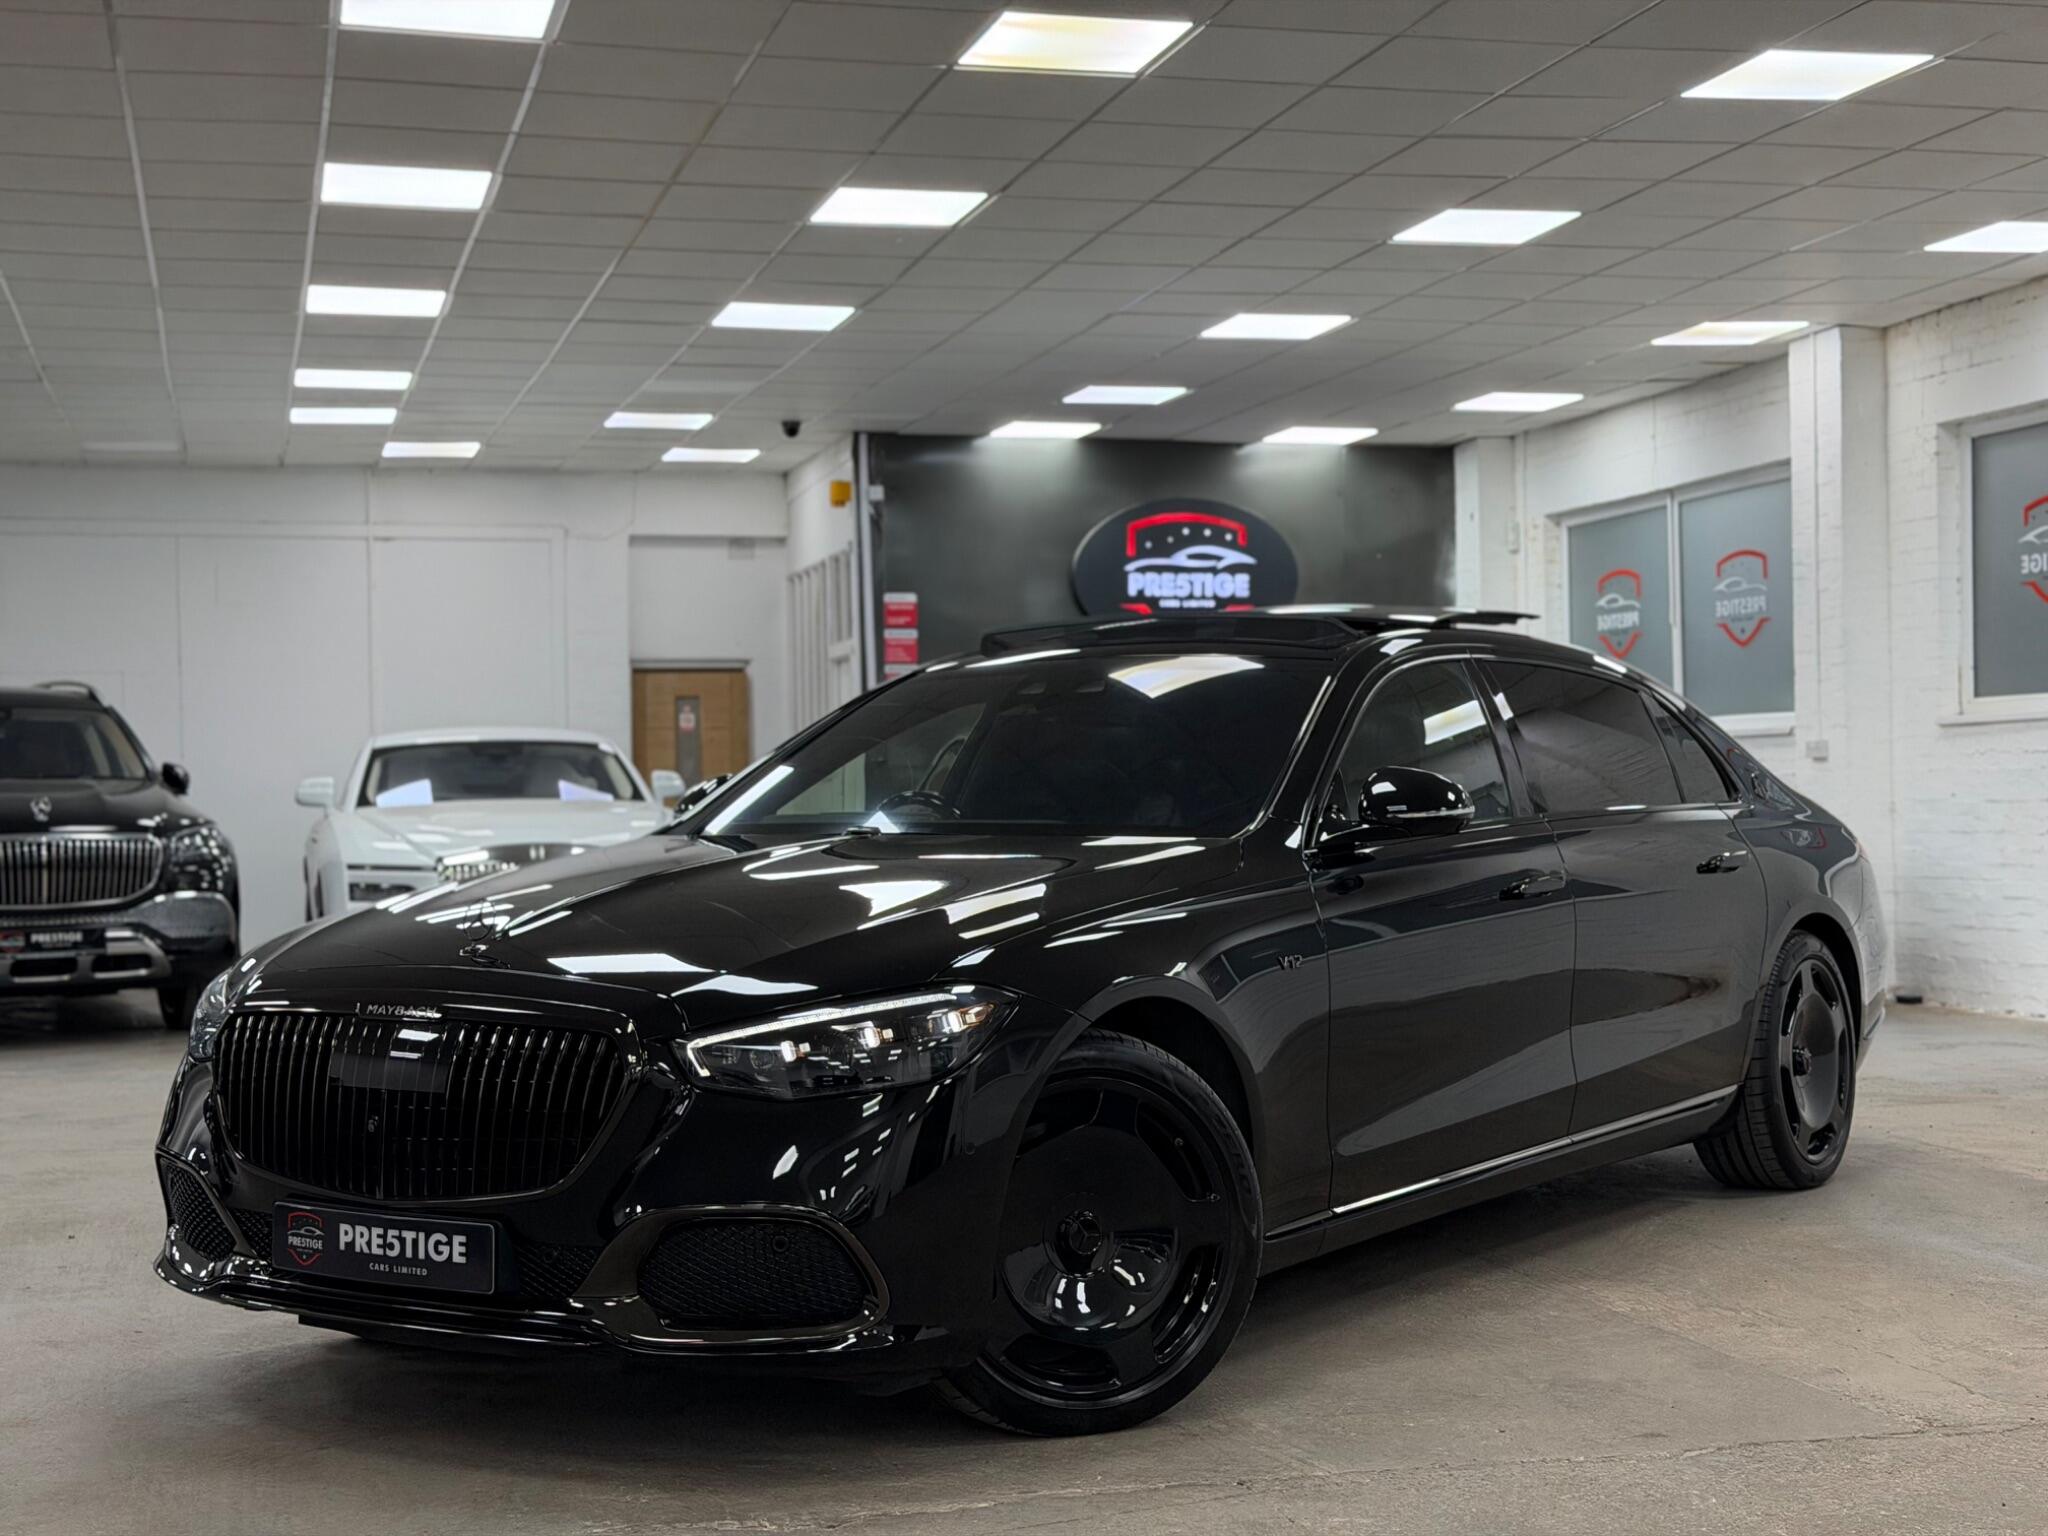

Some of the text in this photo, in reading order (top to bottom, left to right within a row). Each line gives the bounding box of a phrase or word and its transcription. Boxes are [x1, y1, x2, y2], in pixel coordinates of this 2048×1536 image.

[1278, 954, 1304, 970] V12
[366, 1004, 438, 1018] MAYBACH
[369, 1262, 428, 1276] CARS LIMITED
